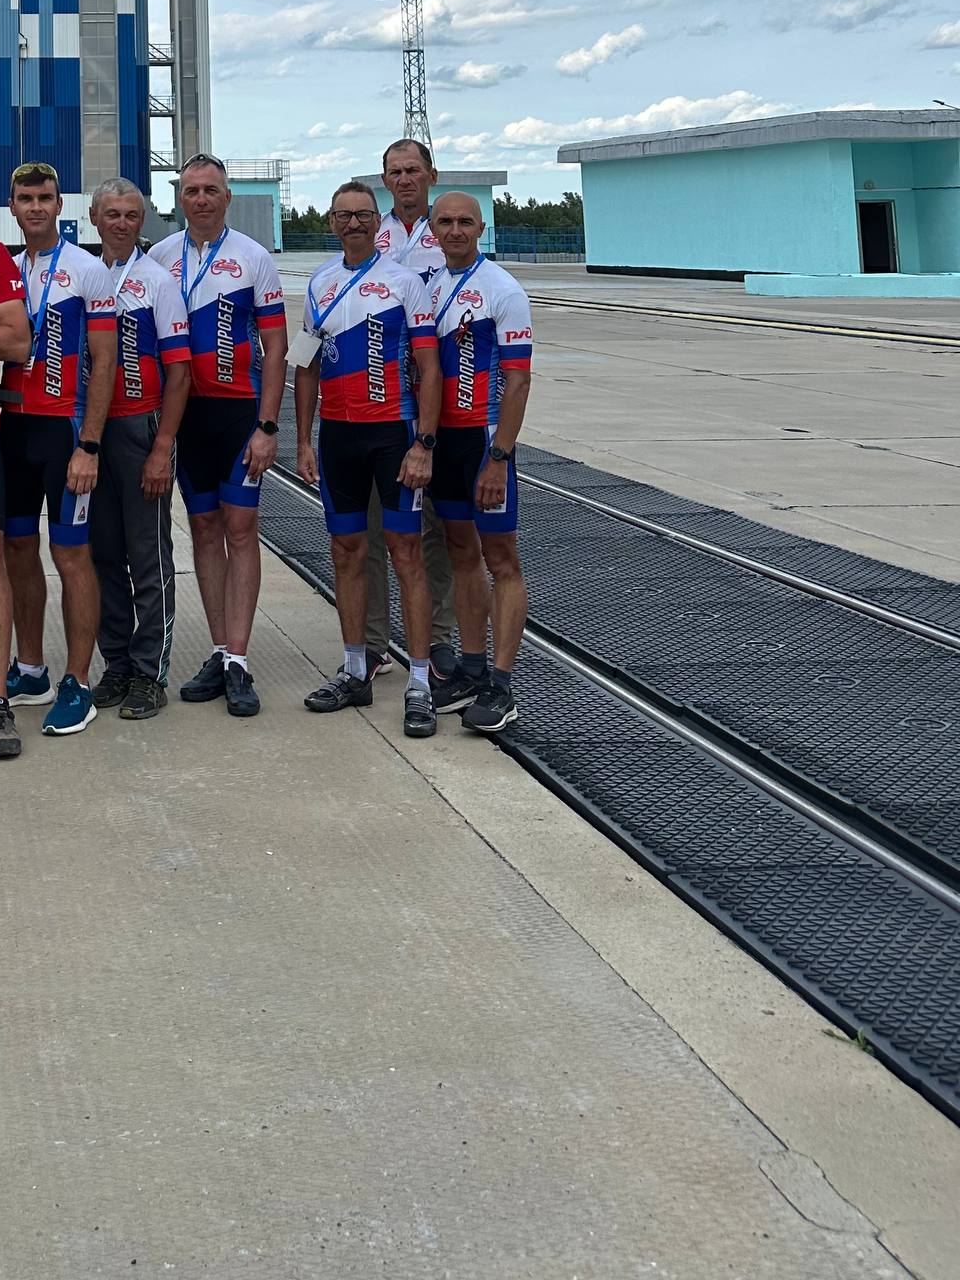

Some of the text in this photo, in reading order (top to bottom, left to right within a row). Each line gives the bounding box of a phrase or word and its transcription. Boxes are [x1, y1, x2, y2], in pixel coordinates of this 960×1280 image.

[45, 302, 63, 397] ВЕЛОПРОБЕГ
[122, 310, 143, 399] ВЕЛОПРОБЕГ
[217, 294, 235, 384] ВЕЛОПРОБЕГ
[366, 313, 386, 403] ВЕЛОПРОБЕГ
